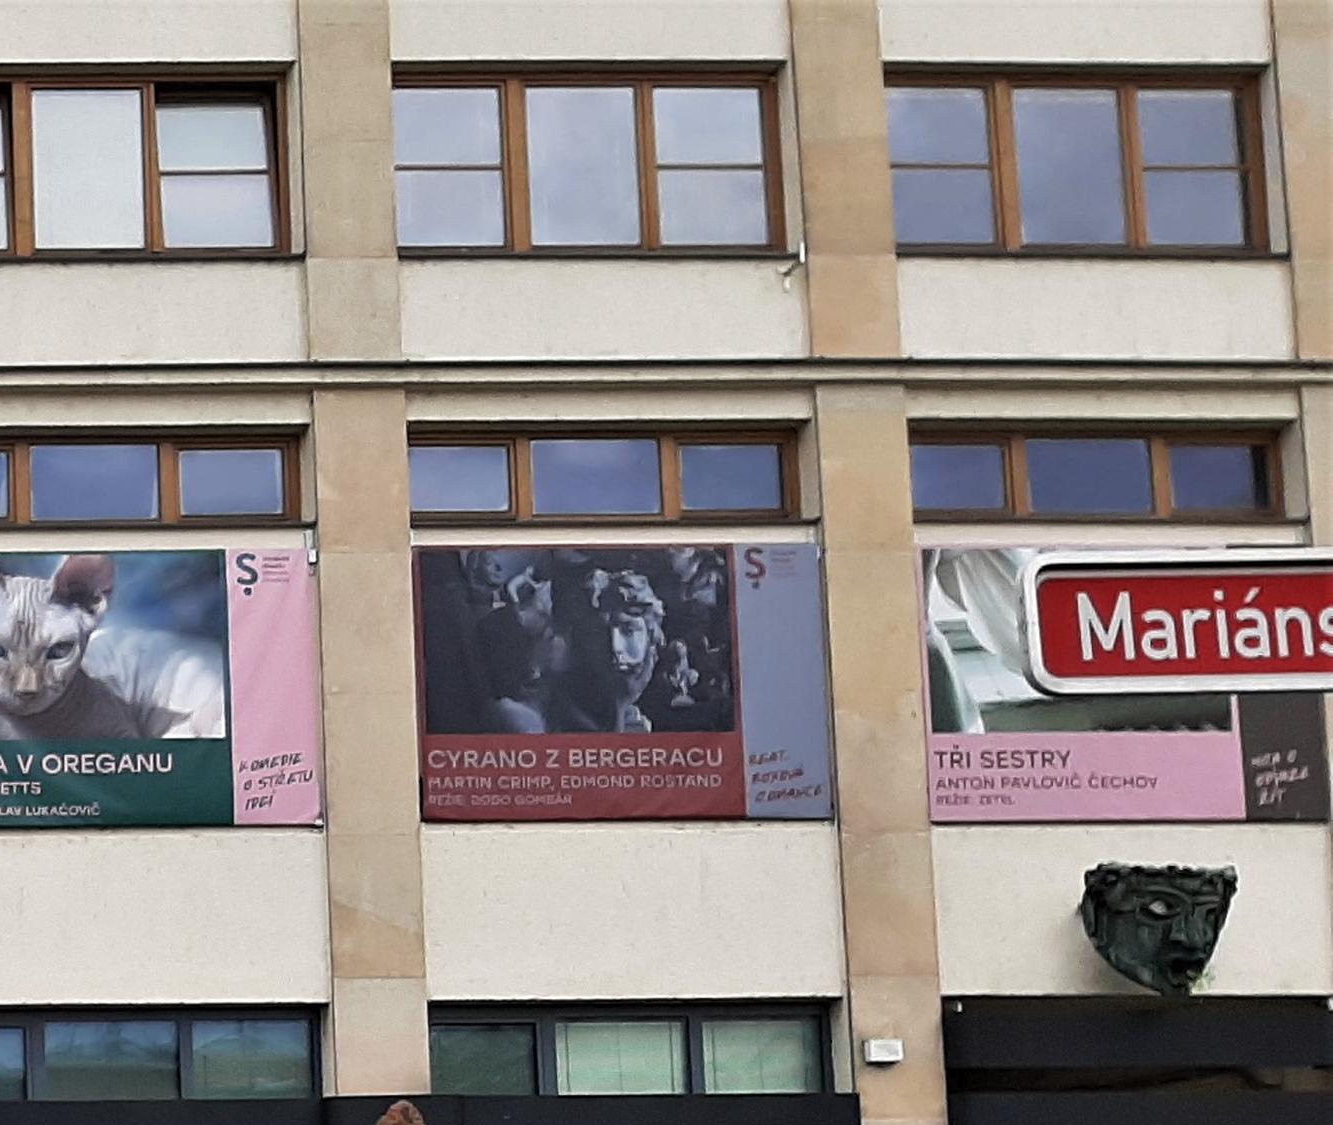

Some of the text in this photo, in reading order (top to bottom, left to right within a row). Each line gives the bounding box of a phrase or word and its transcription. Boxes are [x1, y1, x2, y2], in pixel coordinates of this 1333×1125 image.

[16, 755, 34, 774] V
[41, 753, 173, 774] OREGANU
[427, 748, 724, 769] CYRANO Z BERGERACU
[933, 745, 1071, 769] TŘI SESTRY
[428, 775, 492, 790] MARTIN
[560, 774, 635, 789] EDMOND
[640, 773, 722, 788] ROSTAND
[935, 776, 995, 790] ANTON
